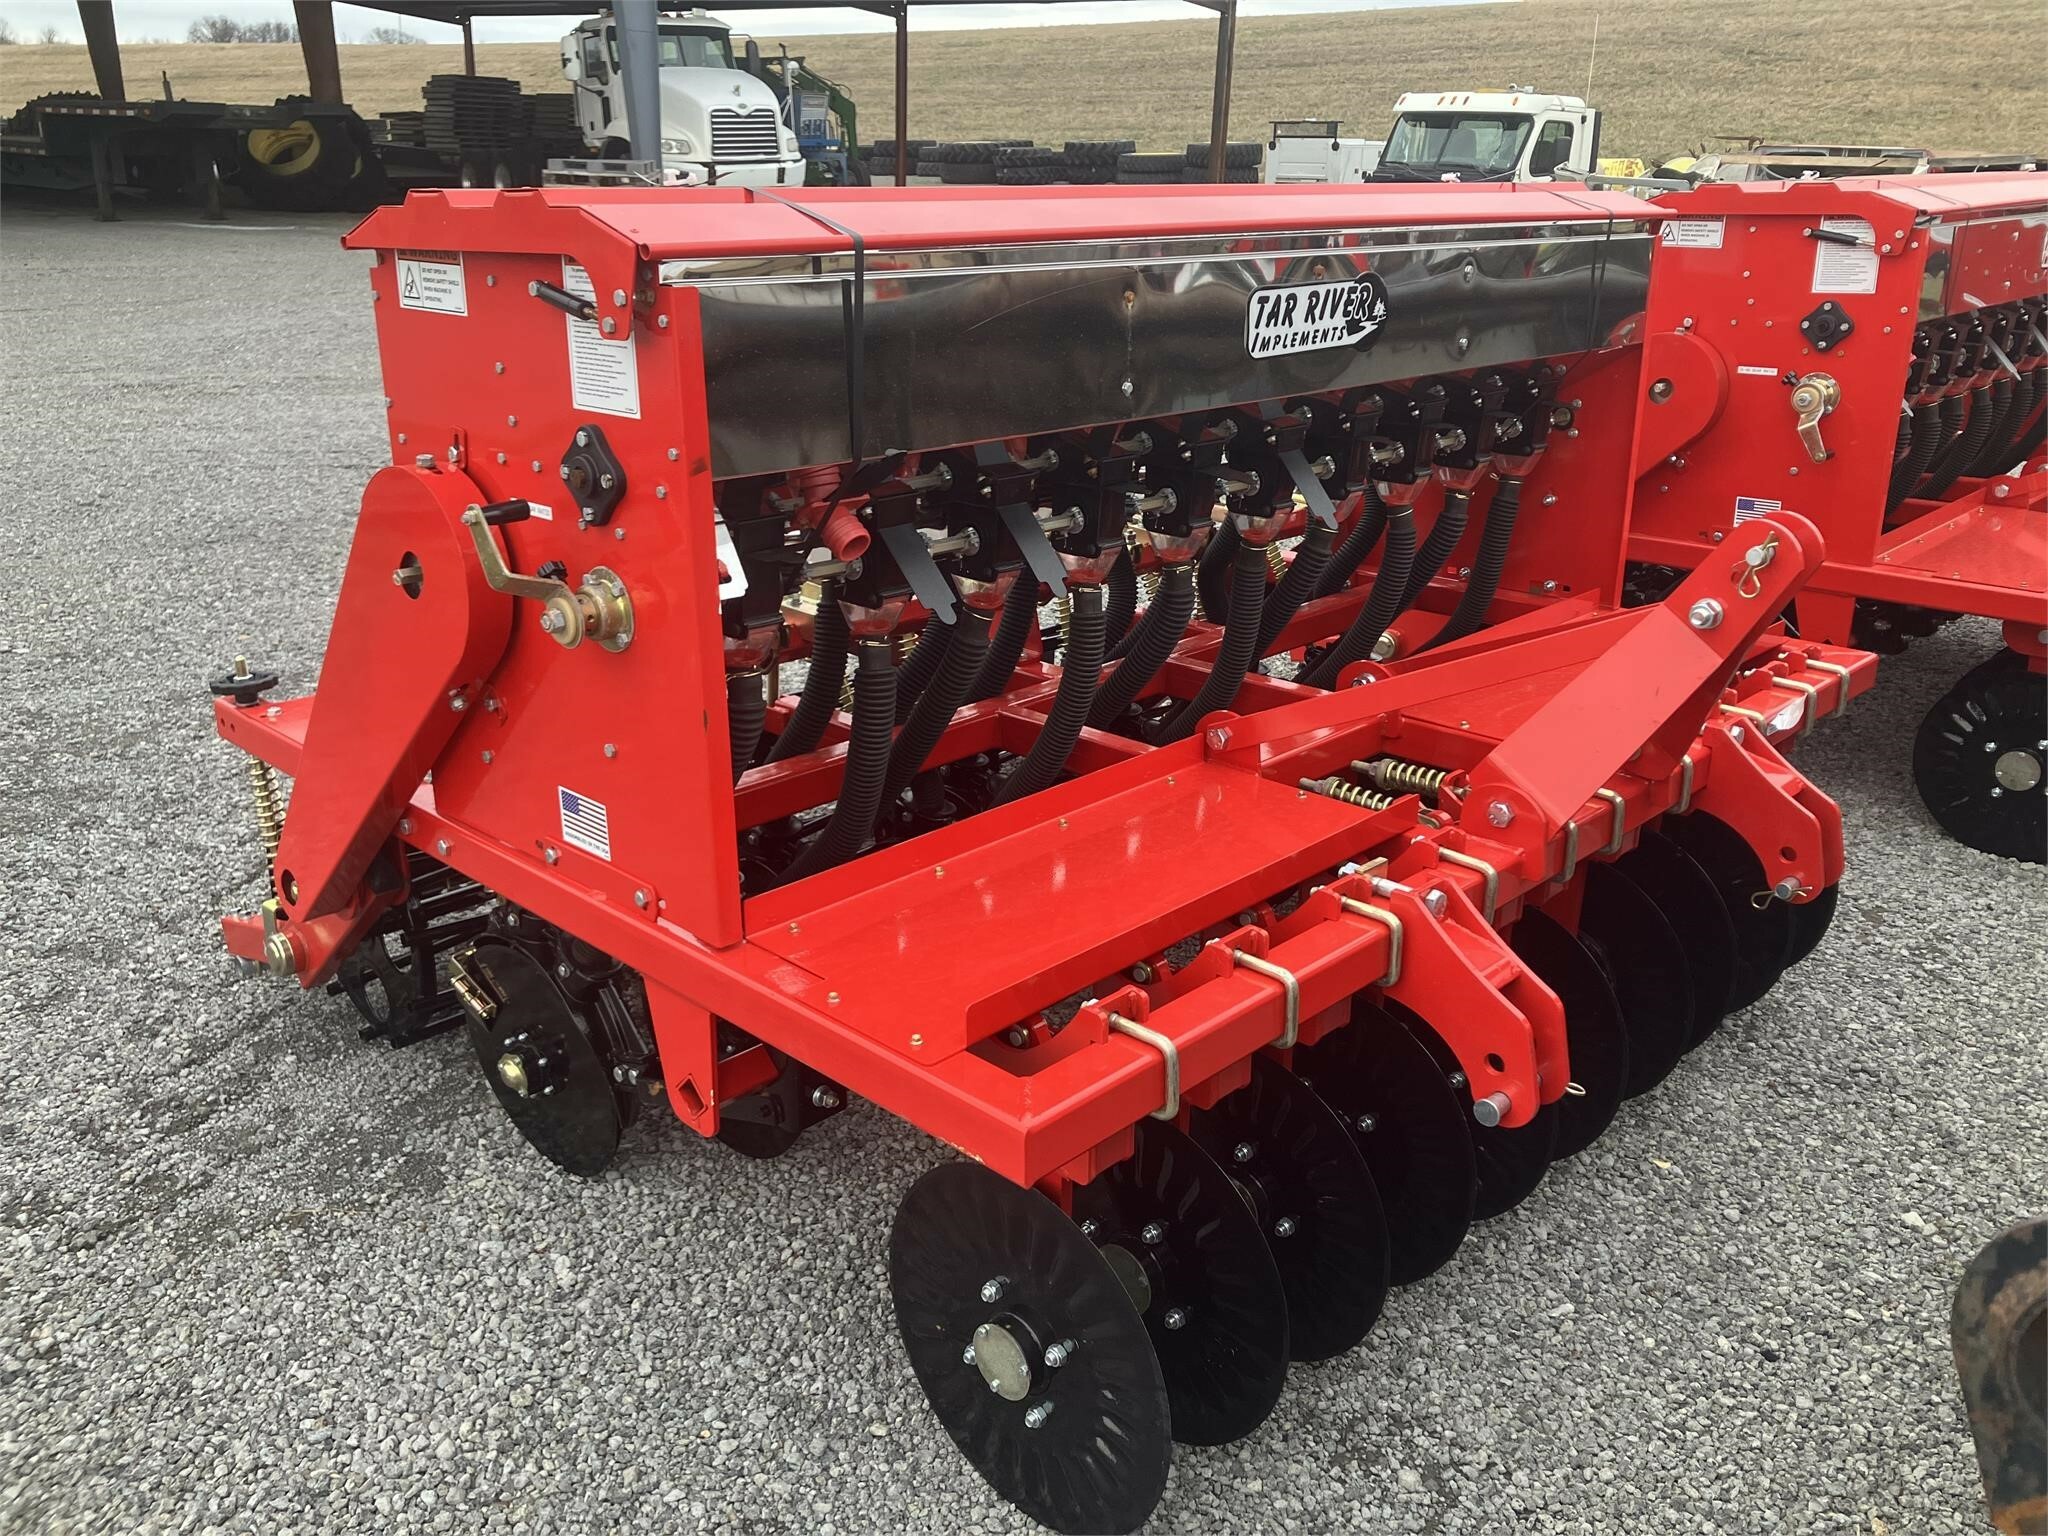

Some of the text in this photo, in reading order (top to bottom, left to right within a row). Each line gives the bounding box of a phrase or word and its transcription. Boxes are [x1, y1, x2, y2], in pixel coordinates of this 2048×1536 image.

[1254, 282, 1373, 330] TAR RIVER
[1250, 325, 1347, 354] IMPLEMENTS
